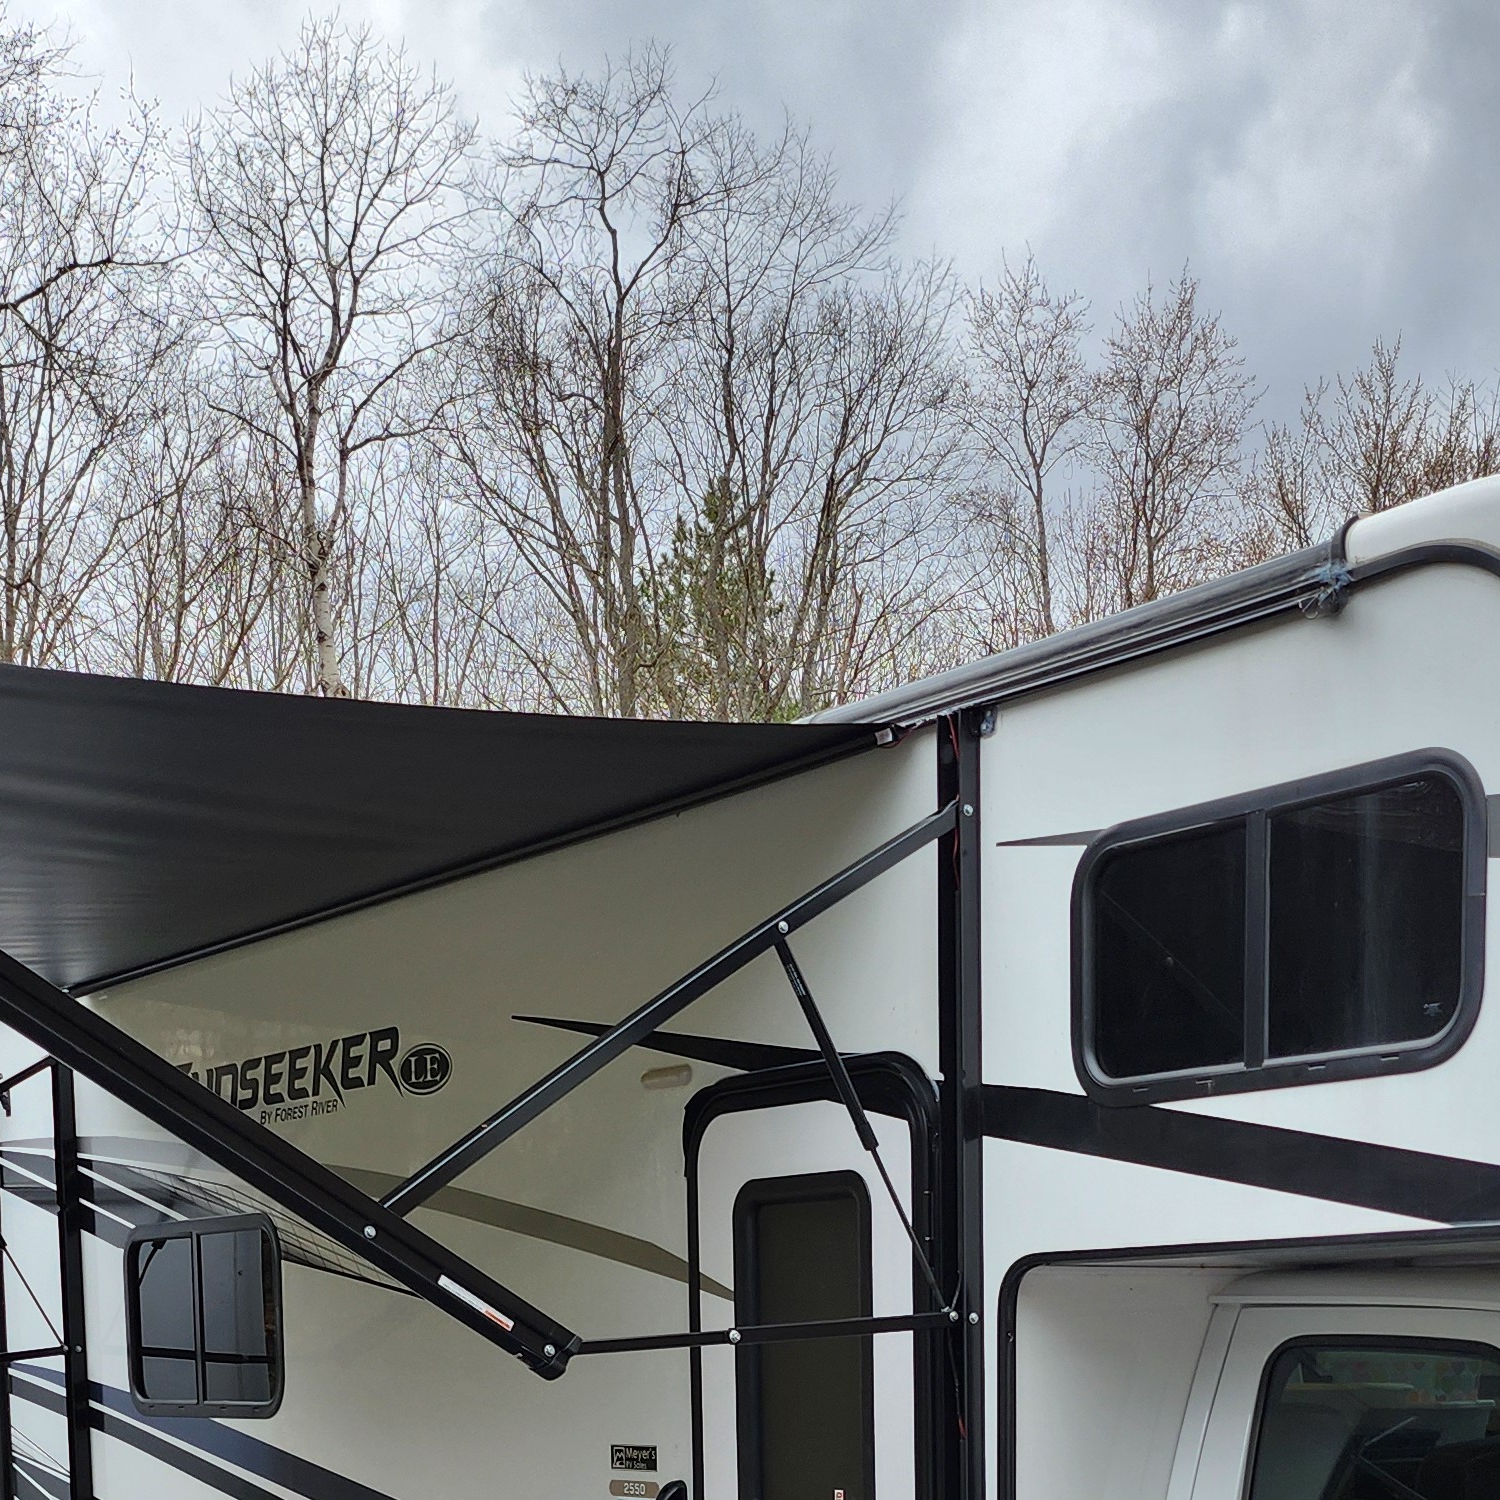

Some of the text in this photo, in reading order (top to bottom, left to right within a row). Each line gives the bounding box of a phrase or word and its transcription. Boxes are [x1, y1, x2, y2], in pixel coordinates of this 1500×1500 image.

[175, 1026, 442, 1111] NSEEKER LE
[260, 1098, 339, 1126] BY FOREST RIVER
[626, 1448, 655, 1462] Meyer's
[623, 1482, 646, 1495] 2550
